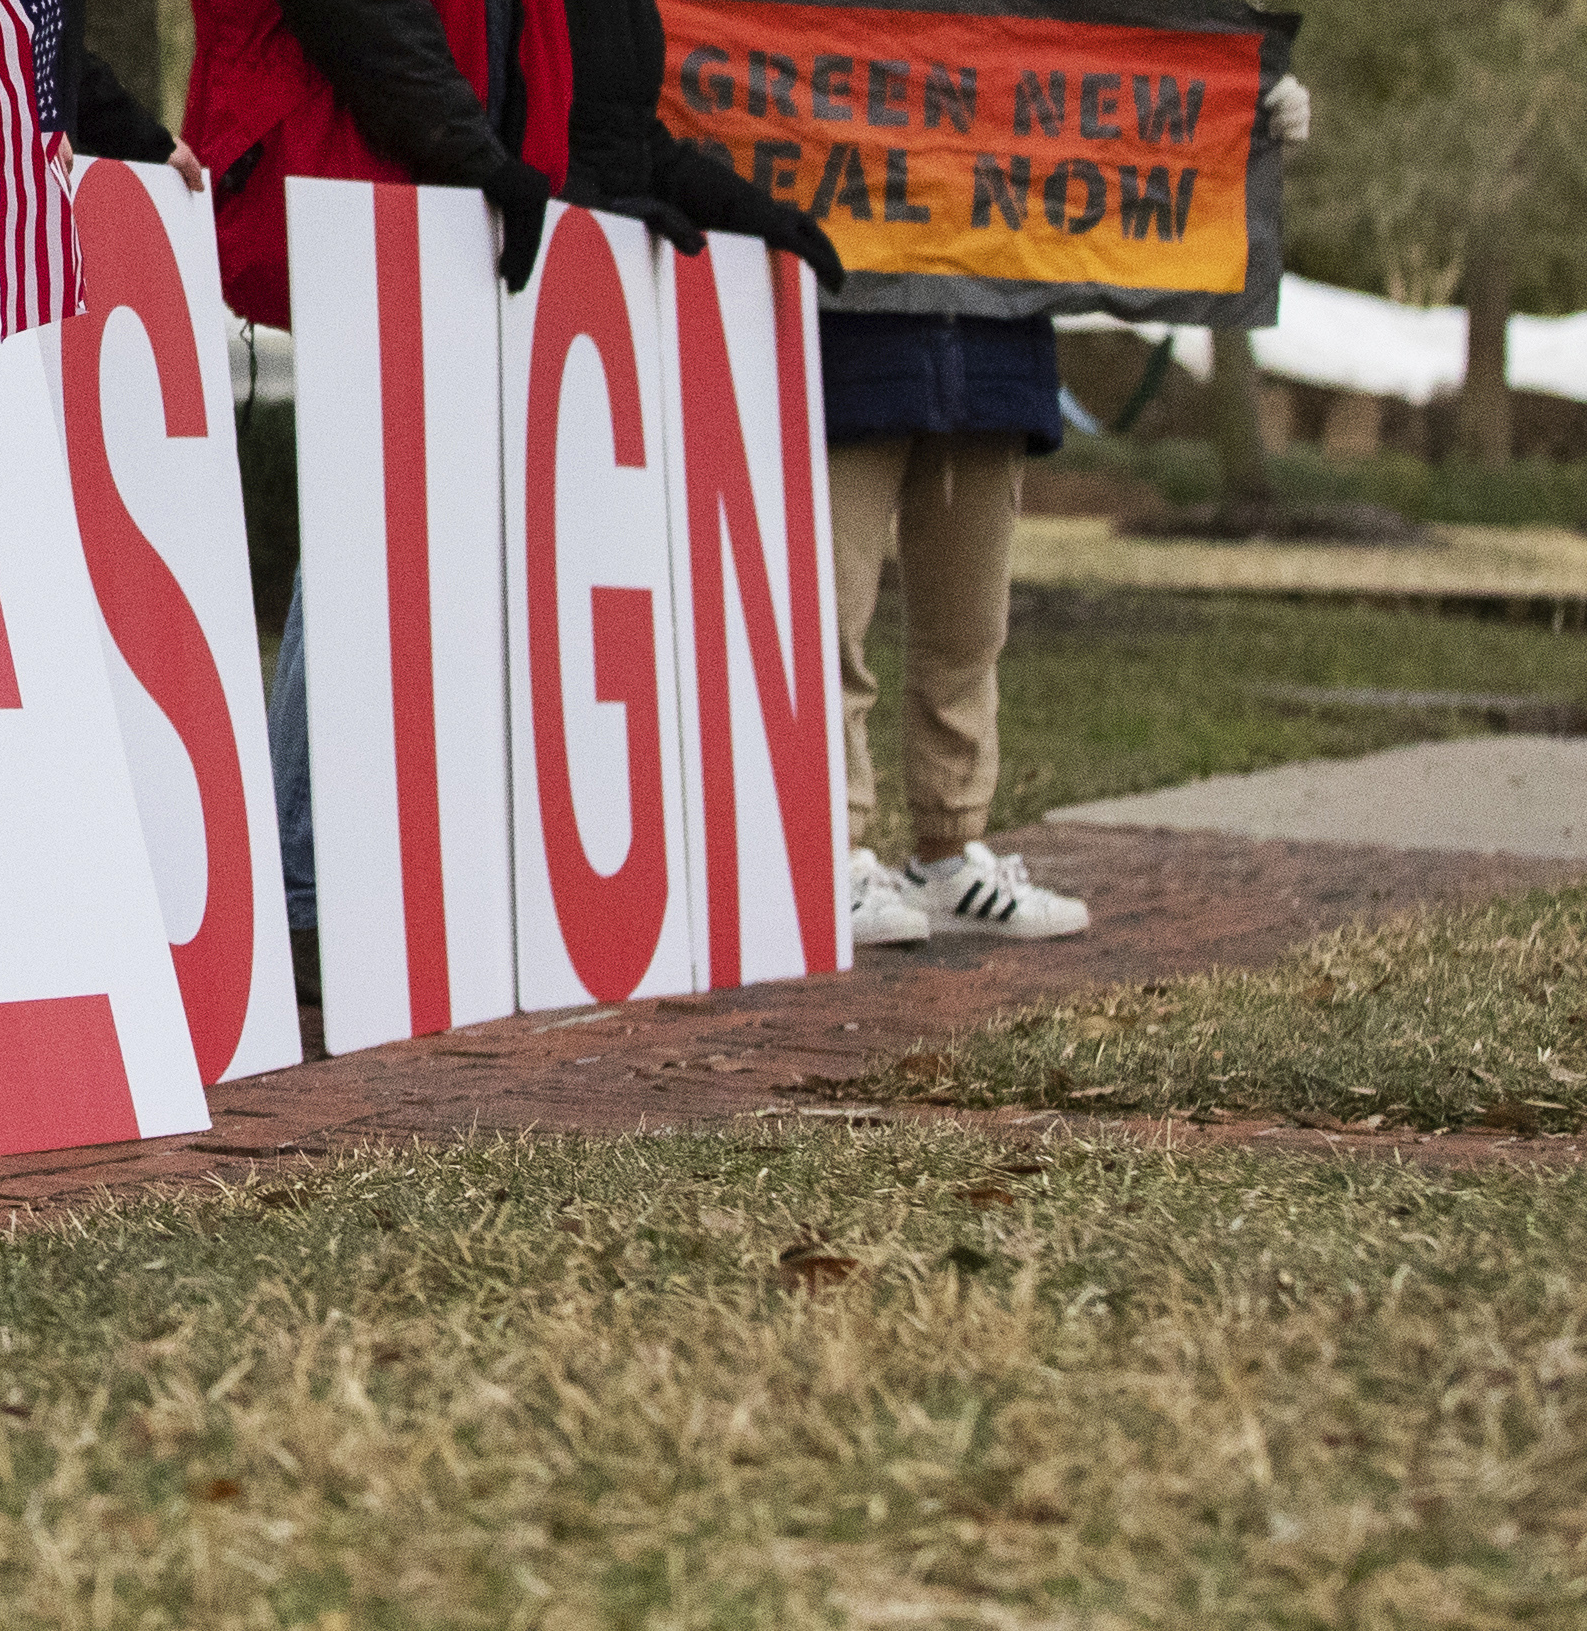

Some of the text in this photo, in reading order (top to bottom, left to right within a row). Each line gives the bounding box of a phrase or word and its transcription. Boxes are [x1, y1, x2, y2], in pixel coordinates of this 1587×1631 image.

[679, 45, 1207, 146] GREEN NEW
[676, 137, 1199, 244] EAL NOW
